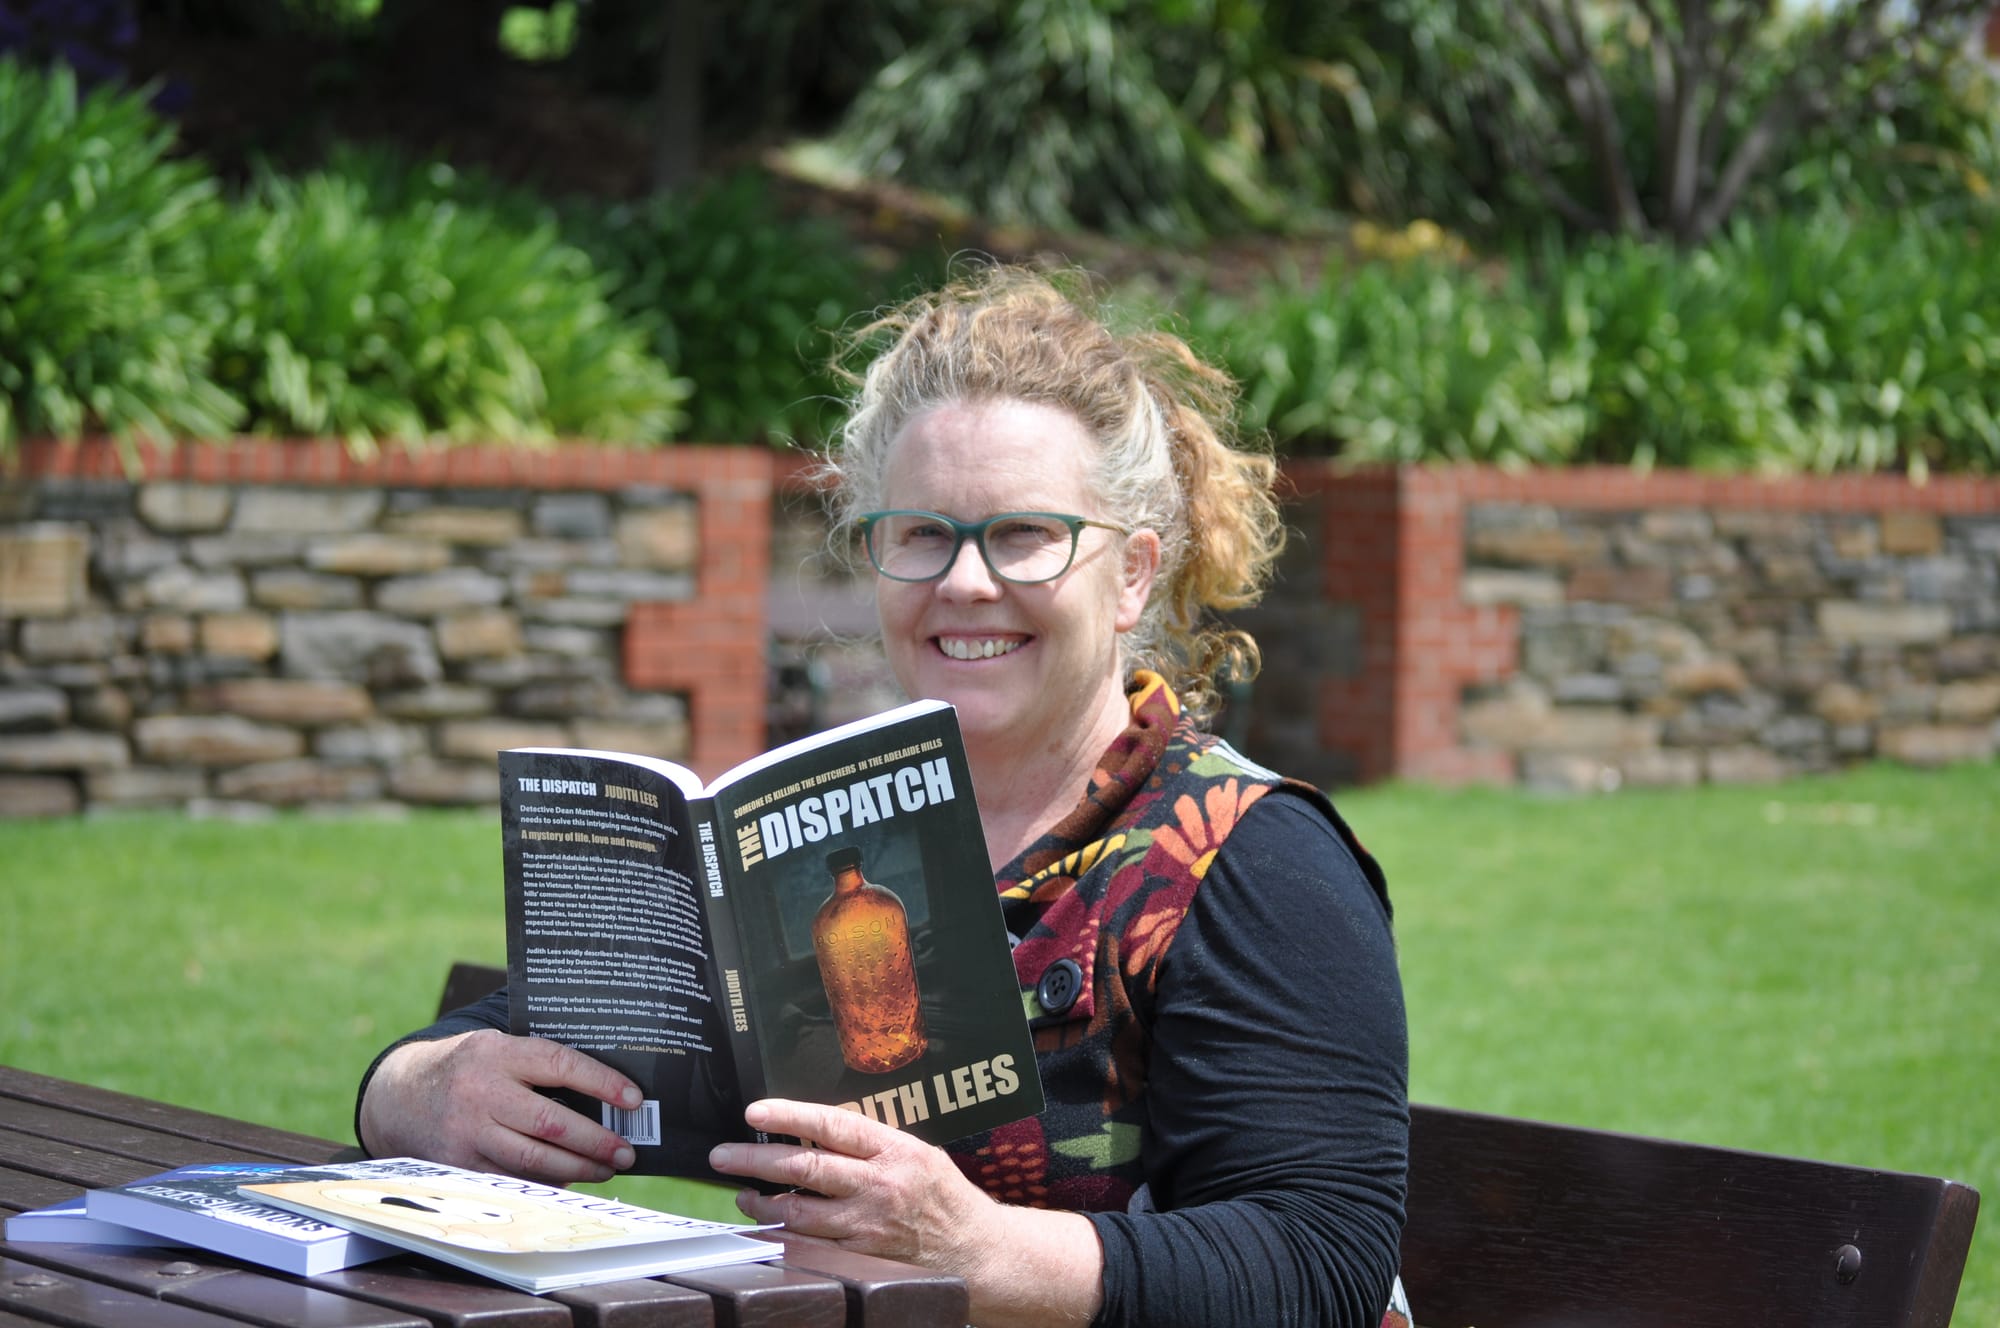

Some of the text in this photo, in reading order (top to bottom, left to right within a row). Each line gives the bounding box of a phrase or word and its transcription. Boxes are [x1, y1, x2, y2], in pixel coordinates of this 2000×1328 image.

[518, 778, 659, 808] THE DISPATCH JUDITH LEES
[733, 738, 943, 819] SOMEONE IS KILLING THE BUTCHERS IN THE ADELAIDE HILLS
[520, 804, 554, 813] Detective
[555, 805, 573, 814] Dean
[575, 807, 607, 818] Matthews
[615, 811, 630, 821] back
[640, 815, 648, 824] the
[520, 815, 542, 823] needs
[552, 816, 570, 825] solve
[572, 818, 585, 826] this
[586, 819, 619, 833] intriguing
[620, 825, 642, 834] murder
[528, 831, 563, 843] mystery
[564, 832, 573, 840] of
[591, 834, 608, 843] love
[610, 837, 625, 845] and
[736, 757, 955, 872] THE DISPATCH
[698, 821, 724, 898] THE DISPATCH
[724, 969, 748, 1033] JUDITH LEES
[932, 1054, 1020, 1115] LEES
